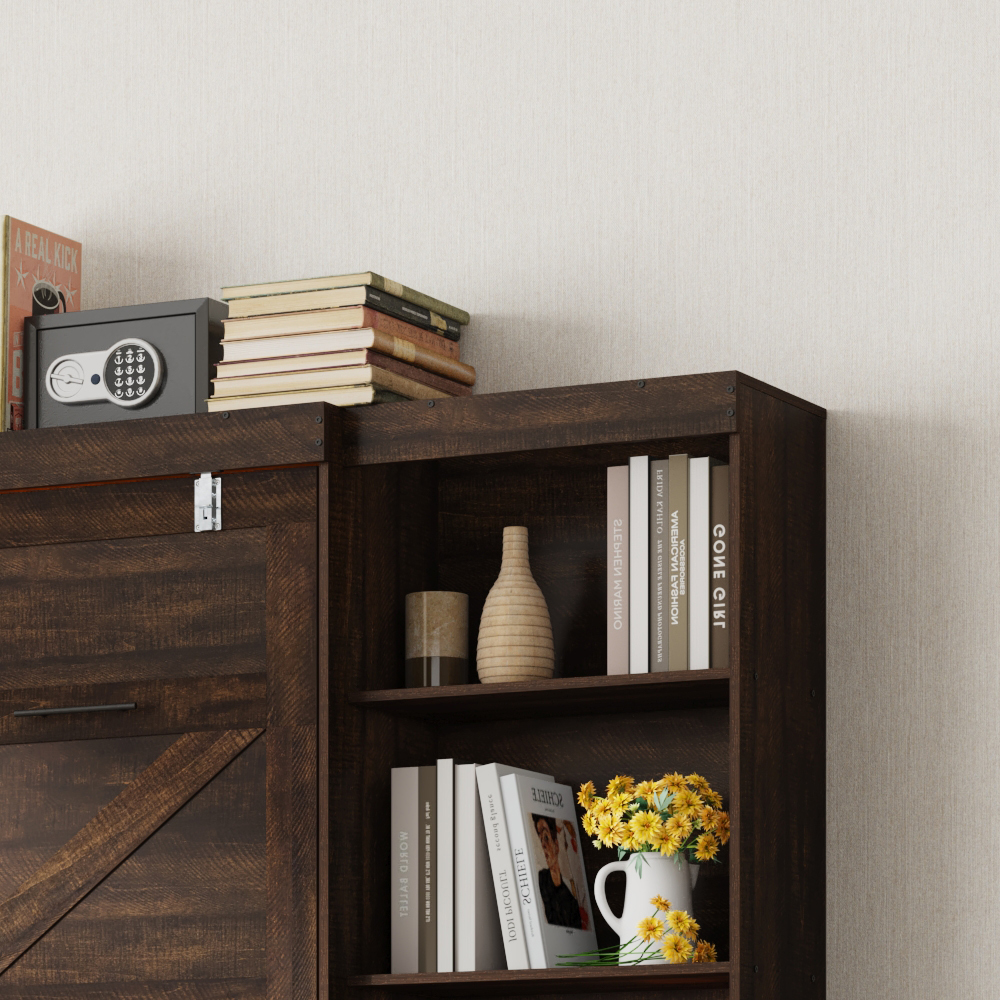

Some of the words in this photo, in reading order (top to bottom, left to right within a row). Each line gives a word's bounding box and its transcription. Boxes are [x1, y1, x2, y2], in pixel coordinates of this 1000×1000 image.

[14, 227, 22, 254] A
[25, 230, 52, 264] REAL
[54, 242, 78, 274] KICK
